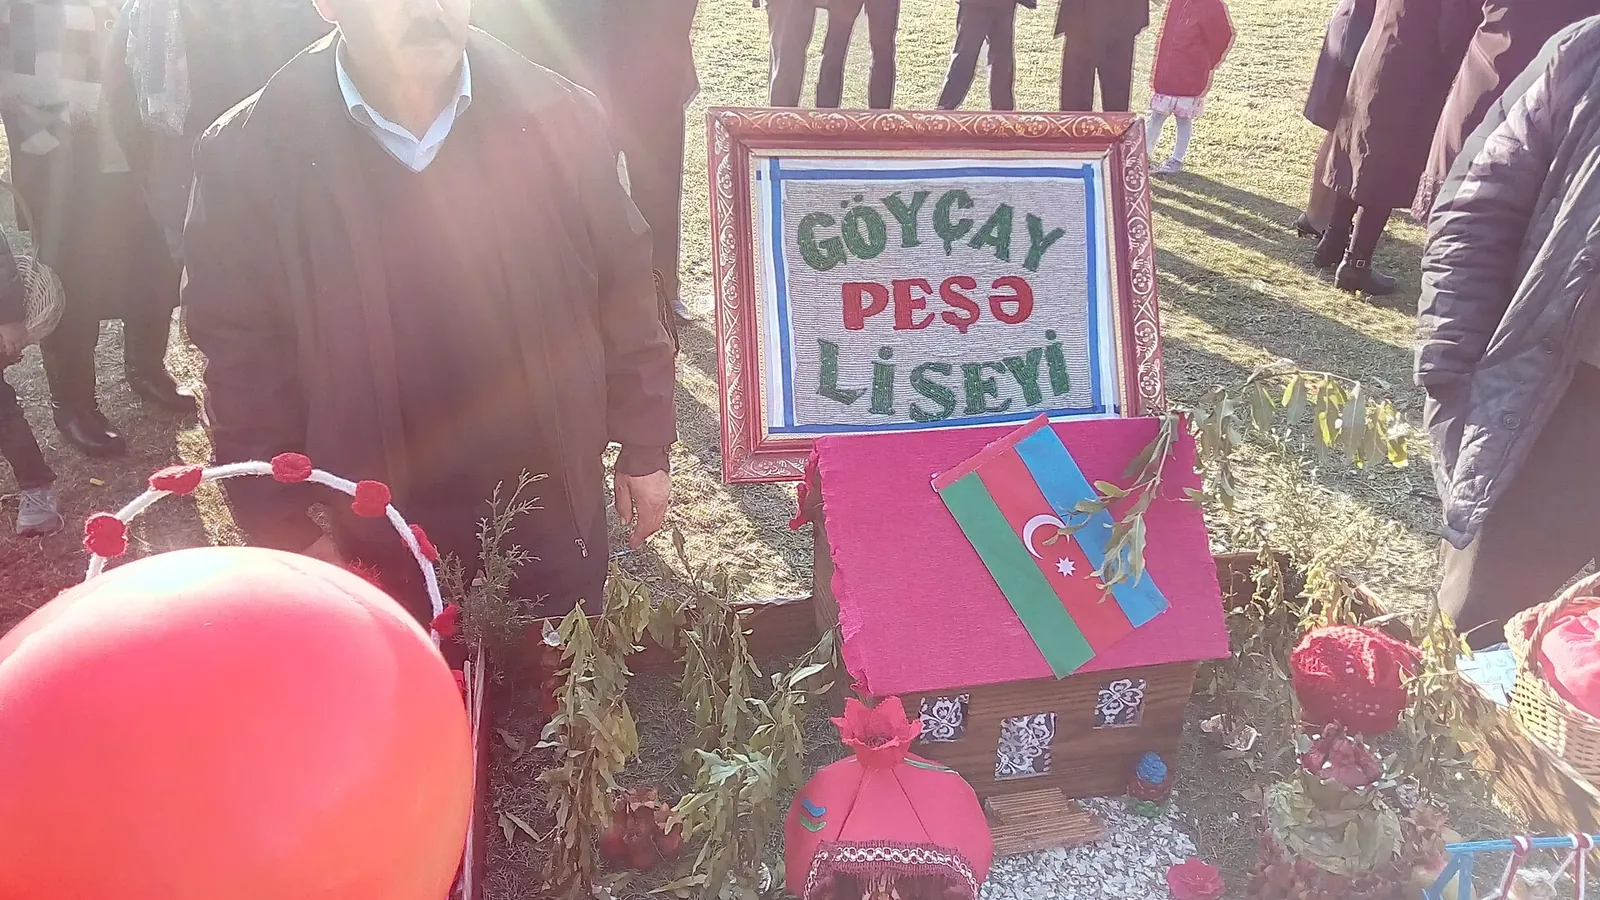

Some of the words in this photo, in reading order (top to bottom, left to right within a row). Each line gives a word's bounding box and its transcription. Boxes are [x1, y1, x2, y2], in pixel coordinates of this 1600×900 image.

[797, 190, 1066, 272] GÖYÇAY
[842, 275, 1034, 334] PEŞƏ
[816, 330, 1070, 423] LİSEYİ
